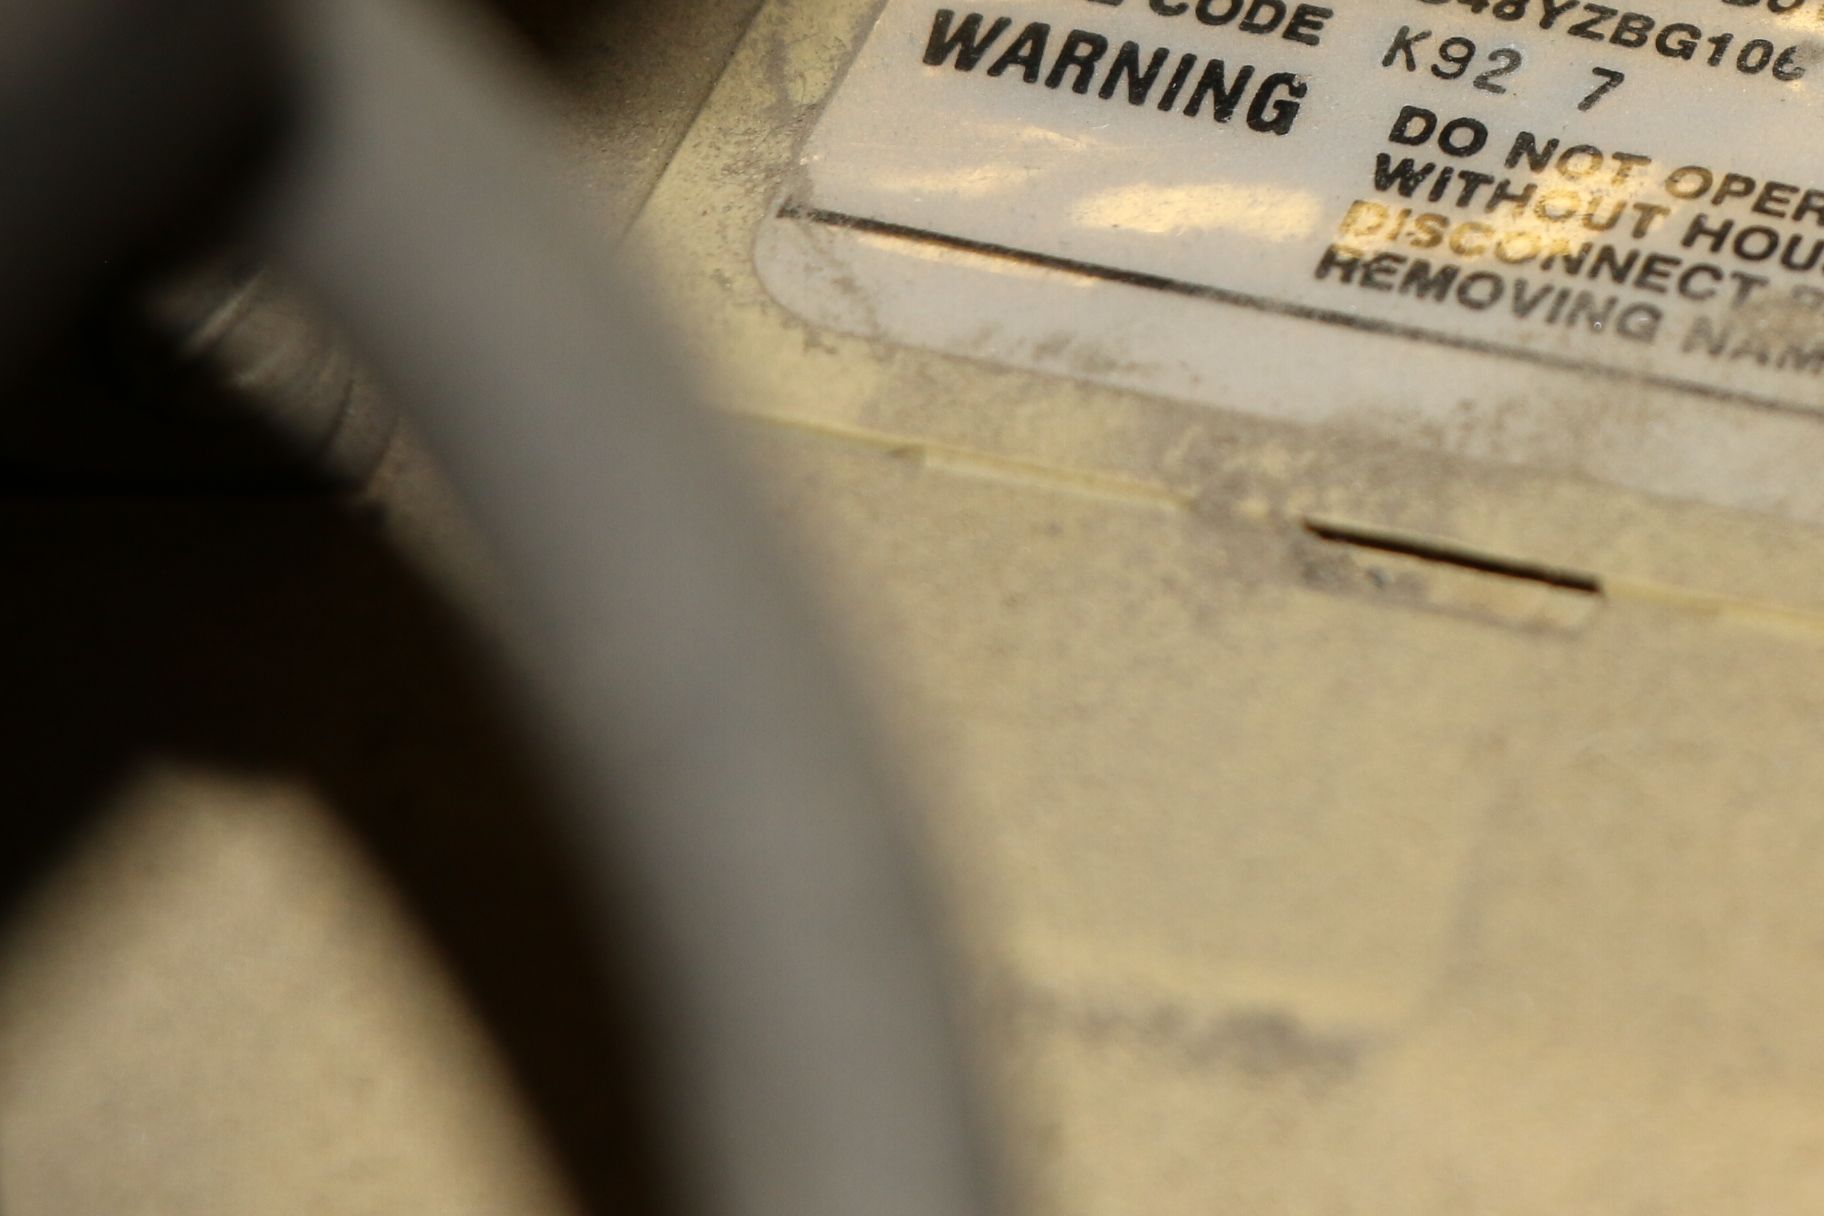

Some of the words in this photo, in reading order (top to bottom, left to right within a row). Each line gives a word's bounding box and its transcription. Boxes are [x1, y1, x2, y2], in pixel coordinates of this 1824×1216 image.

[921, 7, 1309, 137] WARNING
[1380, 24, 1523, 95] K92
[1576, 66, 1626, 113] 7
[1388, 104, 1489, 158] DO
[1504, 130, 1653, 186] NOT
[1372, 152, 1672, 239] WITHOUT
[1314, 243, 1665, 344] REMOVING
[1337, 198, 1772, 311] DISCONNECT
